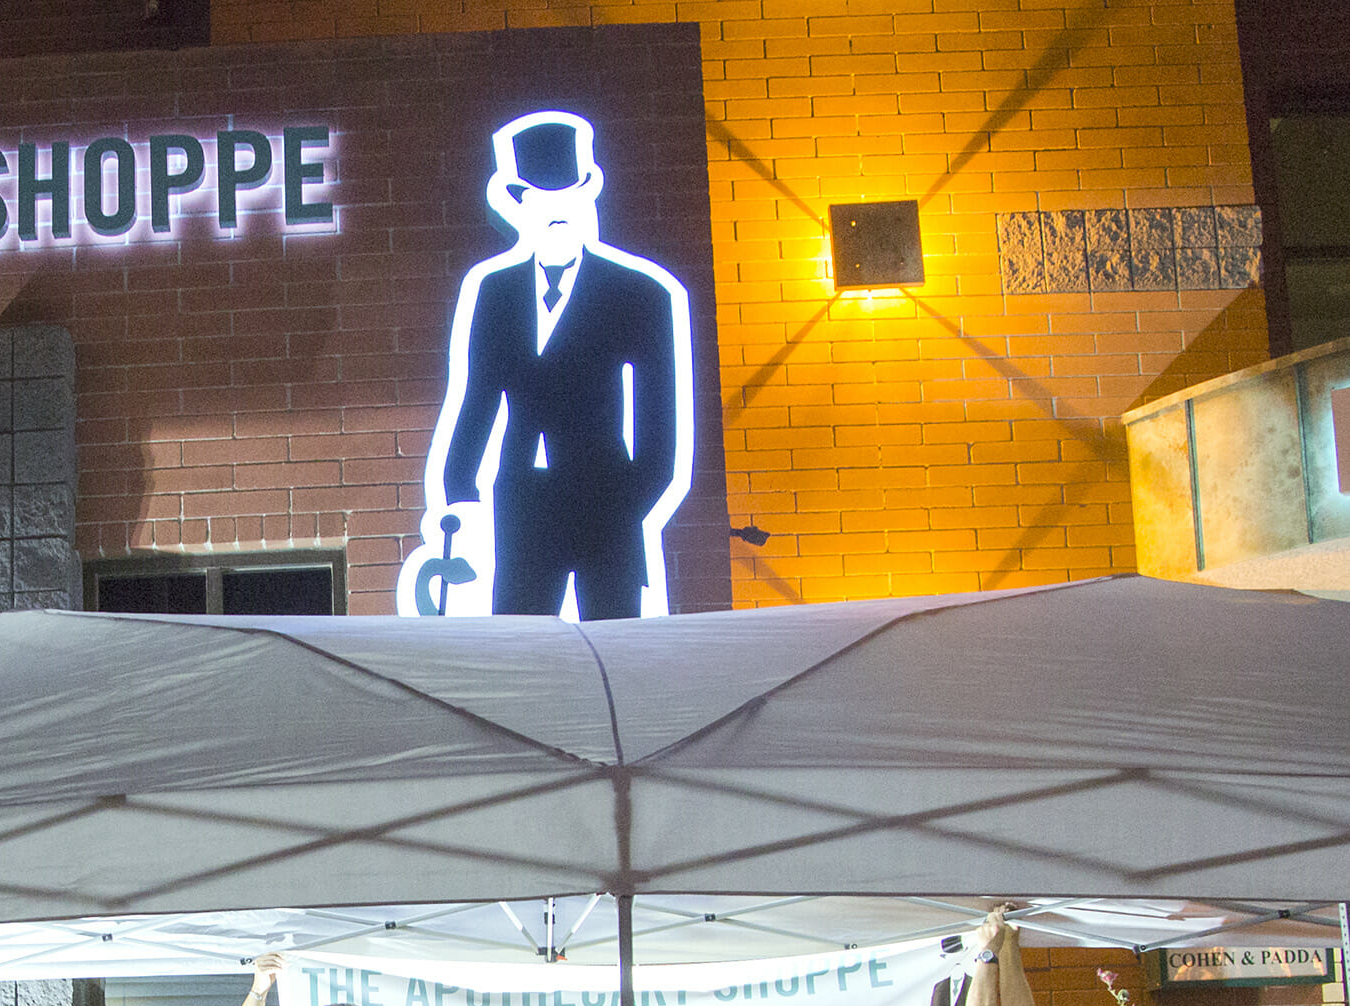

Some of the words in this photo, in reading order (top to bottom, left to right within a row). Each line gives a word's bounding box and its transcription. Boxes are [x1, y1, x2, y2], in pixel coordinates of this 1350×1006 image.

[1169, 951, 1235, 969] COHEN
[1241, 951, 1255, 965] &
[1261, 949, 1322, 965] PADDA
